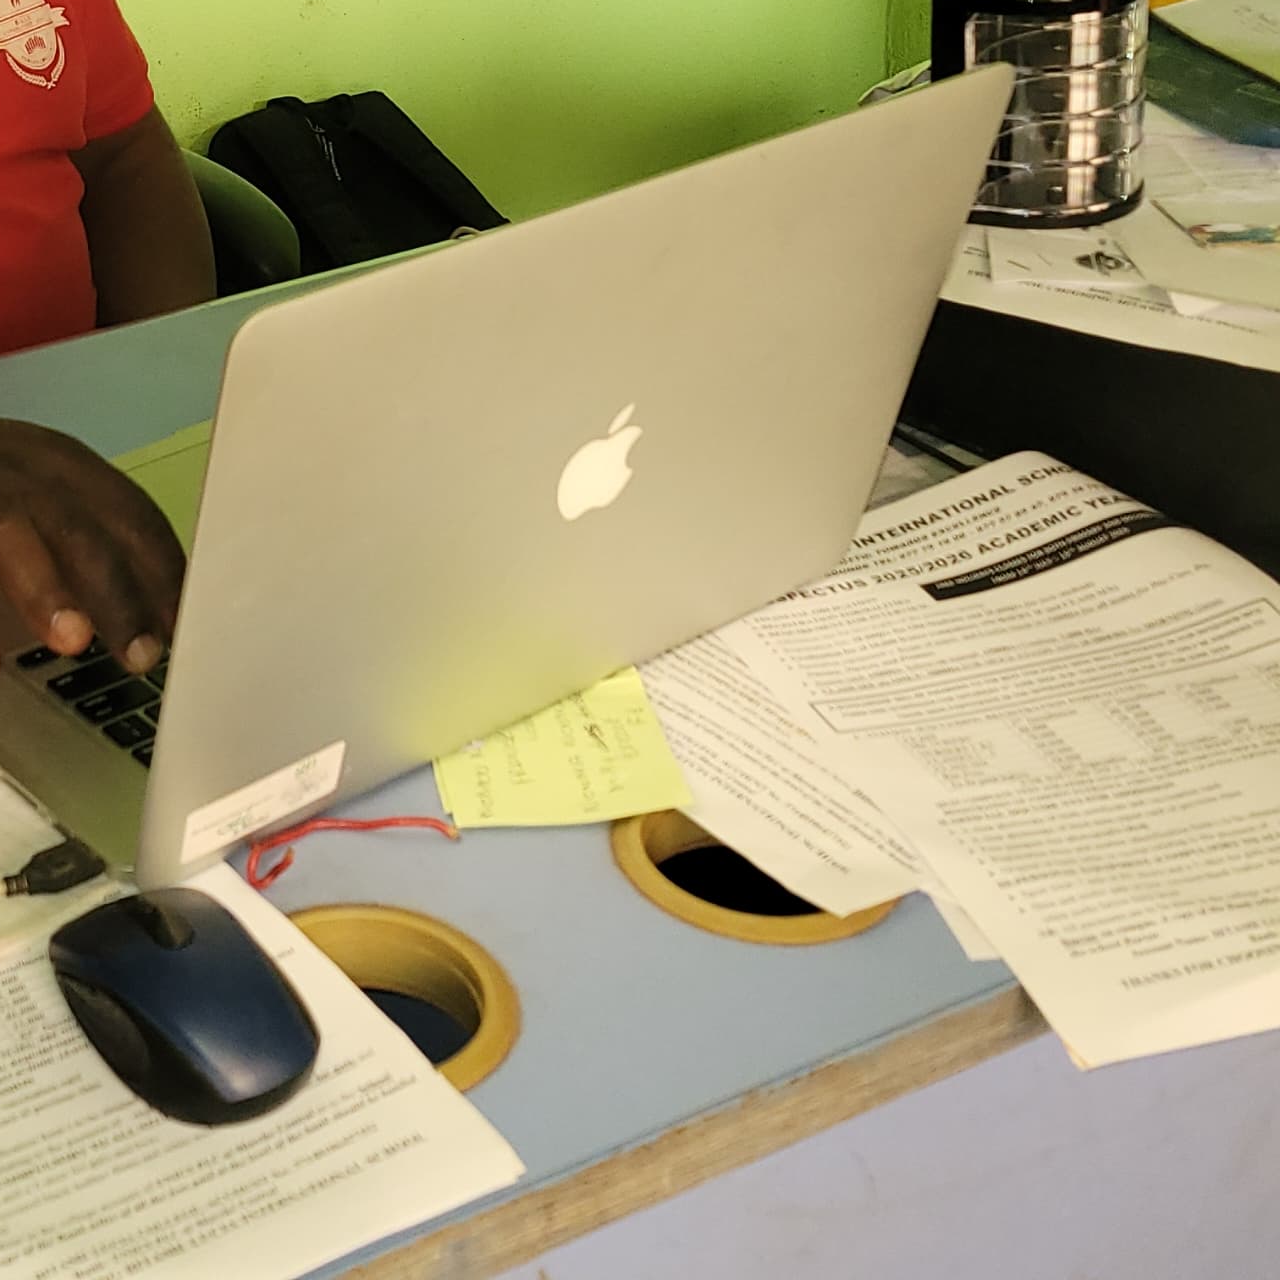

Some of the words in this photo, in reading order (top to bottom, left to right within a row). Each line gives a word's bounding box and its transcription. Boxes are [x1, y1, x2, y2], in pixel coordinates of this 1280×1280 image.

[850, 484, 1017, 549] INTERNATIONAL
[1017, 464, 1075, 487] SCHO
[977, 505, 1083, 556] ACADEMIC
[1084, 493, 1133, 510] YEA
